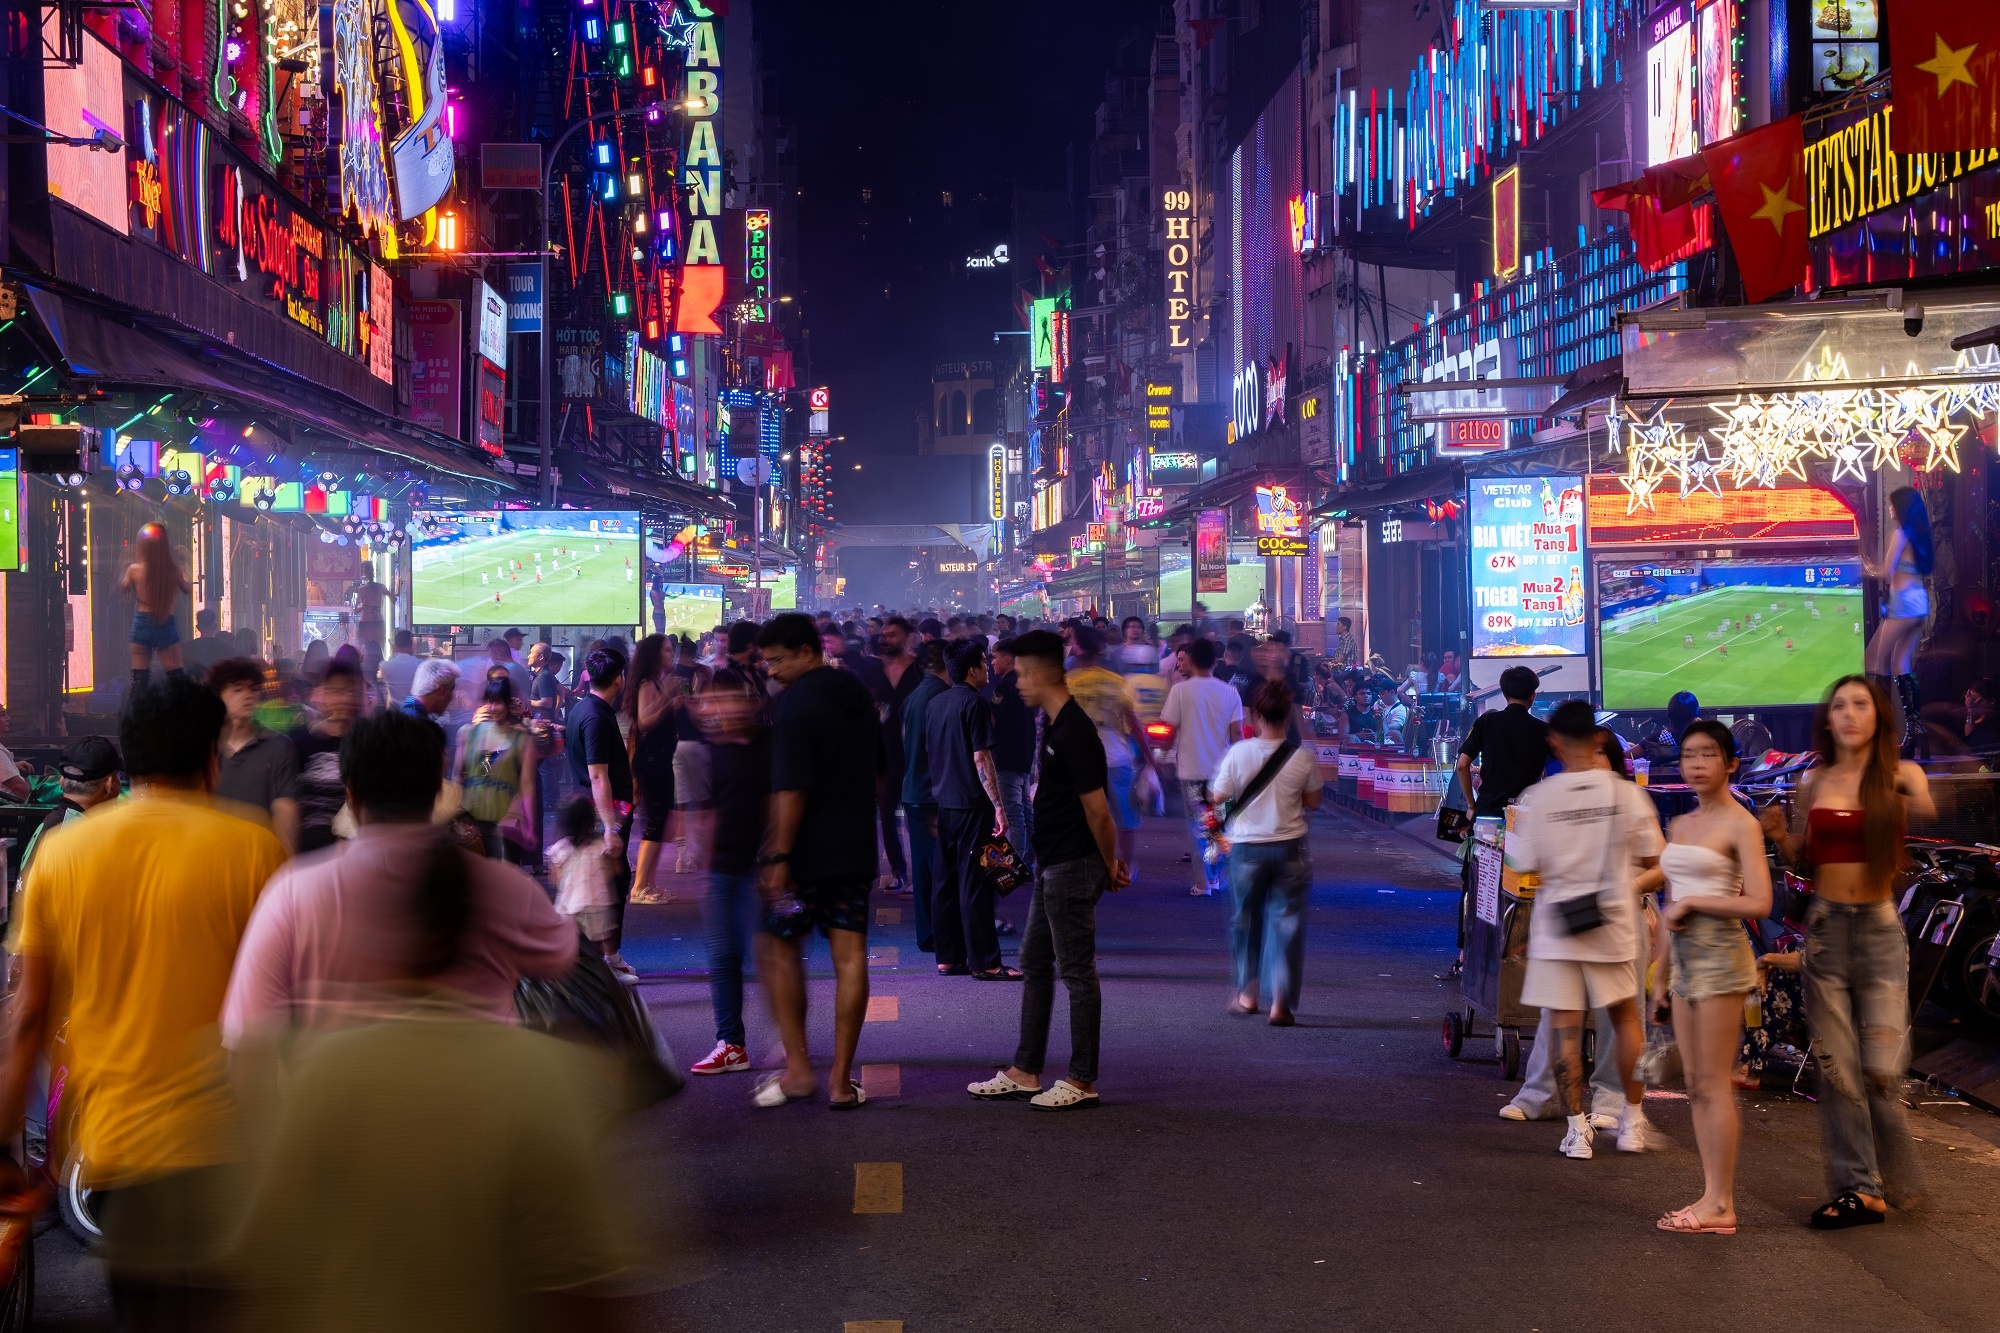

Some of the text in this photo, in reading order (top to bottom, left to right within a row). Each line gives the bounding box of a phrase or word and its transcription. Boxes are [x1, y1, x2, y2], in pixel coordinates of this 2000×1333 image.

[1654, 22, 1664, 42] SPA
[1669, 6, 1682, 32] NAIL
[1164, 191, 1190, 211] 99
[747, 213, 769, 230] 86
[509, 276, 534, 292] TOUR
[1166, 217, 1190, 347] HOTEL
[507, 303, 542, 320] OOKING
[580, 326, 600, 343] TÓC
[559, 346, 578, 355] HAIR
[1147, 384, 1172, 396] Crowne
[816, 393, 827, 405] K
[1482, 484, 1532, 496] VIETSTAR
[1493, 497, 1532, 508] Club
[1258, 511, 1302, 534] Tiger
[1258, 538, 1290, 549] COC
[1473, 522, 1531, 551] BIA VIỆT
[1533, 523, 1578, 552] Mua 1
[940, 563, 965, 572] PASTEUR
[1491, 556, 1516, 568] 67K
[1522, 555, 1539, 565] BUY
[1546, 555, 1562, 565] GET
[1818, 567, 1841, 577] VTV6
[1523, 577, 1564, 594] Mua 2
[1474, 586, 1518, 607] TIGER
[1555, 595, 1564, 610] 1
[1488, 615, 1513, 627] 89K
[1518, 618, 1534, 628] BUY
[1543, 618, 1558, 628] GET
